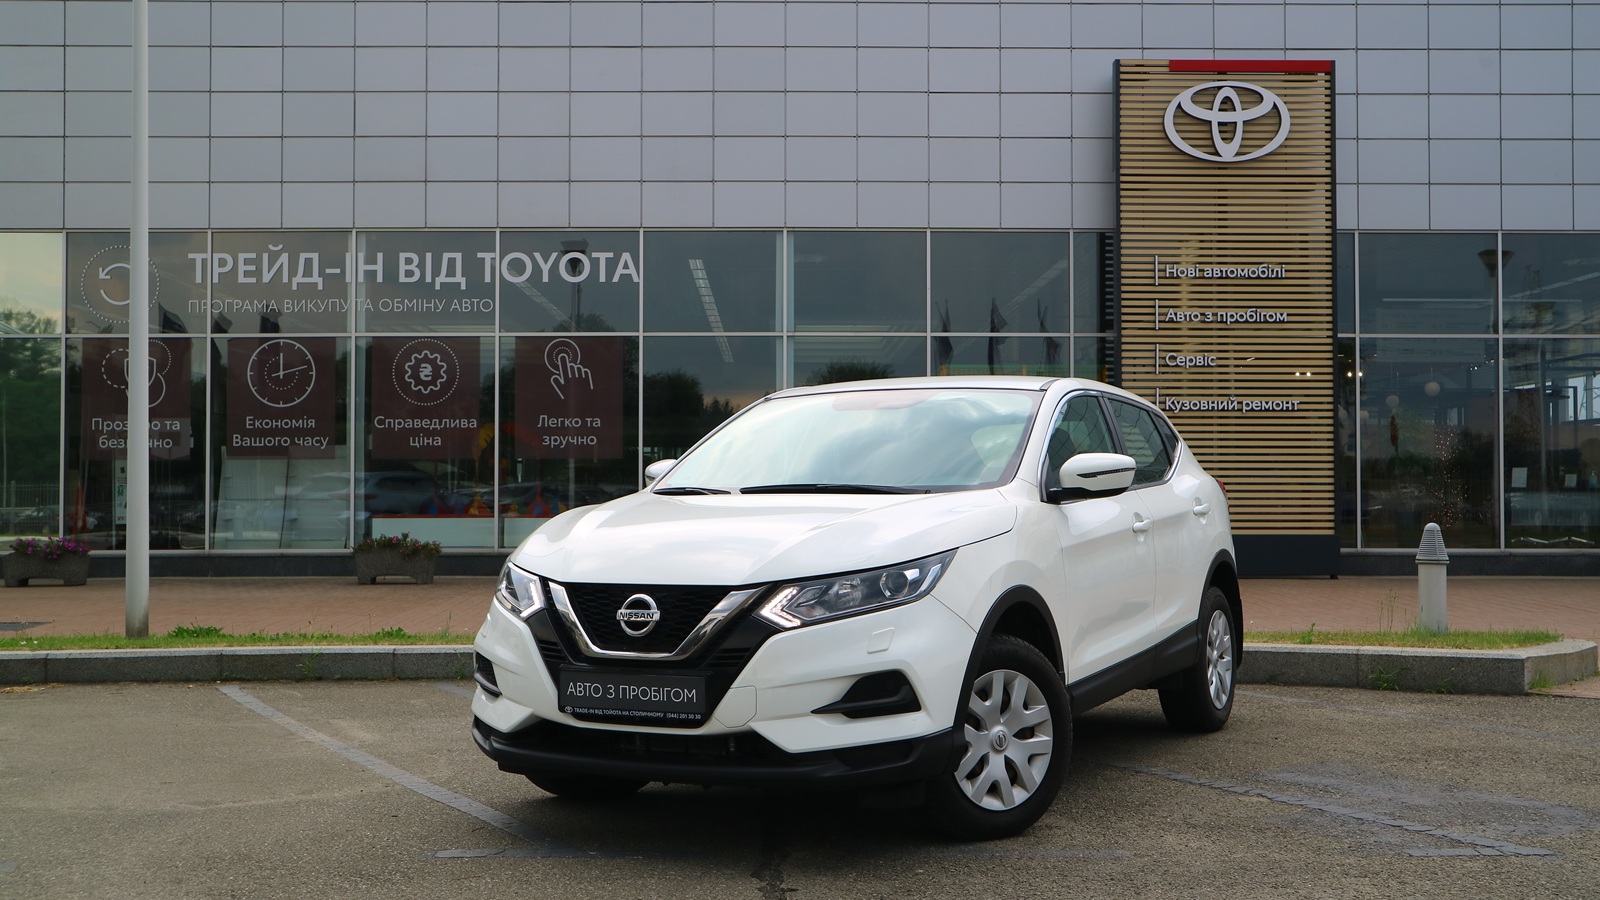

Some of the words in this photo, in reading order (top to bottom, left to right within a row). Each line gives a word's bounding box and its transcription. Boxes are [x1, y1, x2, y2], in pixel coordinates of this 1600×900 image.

[188, 244, 383, 290] ТРЕЙД-ІН
[399, 252, 466, 290] ВІД
[477, 252, 640, 283] TOYOTA
[1165, 264, 1200, 278] Нові
[1203, 264, 1286, 278] автомобілі
[188, 299, 279, 313] ПРОГРАМА
[284, 299, 351, 313] ВИКУПУ
[355, 298, 374, 312] ТА
[378, 298, 446, 312] ОБМІНУ
[450, 298, 493, 312] АВТО
[1165, 308, 1200, 322] Авто
[1204, 310, 1213, 322] з
[1217, 308, 1288, 324] пробігом
[1165, 353, 1217, 368] Сервіс
[1165, 397, 1238, 413] Кузовний
[1242, 400, 1300, 413] ремонт
[91, 417, 161, 434] Прозо
[164, 420, 181, 431] та
[245, 416, 316, 429] Економія
[374, 416, 478, 432] Справедлива
[537, 415, 582, 429] Легко
[585, 417, 602, 429] та
[99, 435, 173, 448] безно
[232, 434, 291, 447] Вашого
[294, 436, 329, 449] часу
[409, 434, 442, 448] ціна
[542, 435, 597, 448] зручно
[619, 611, 654, 620] NISSAN
[567, 682, 603, 698] АВТО
[606, 684, 615, 699] З
[619, 686, 697, 703] ПРОБІГОМ
